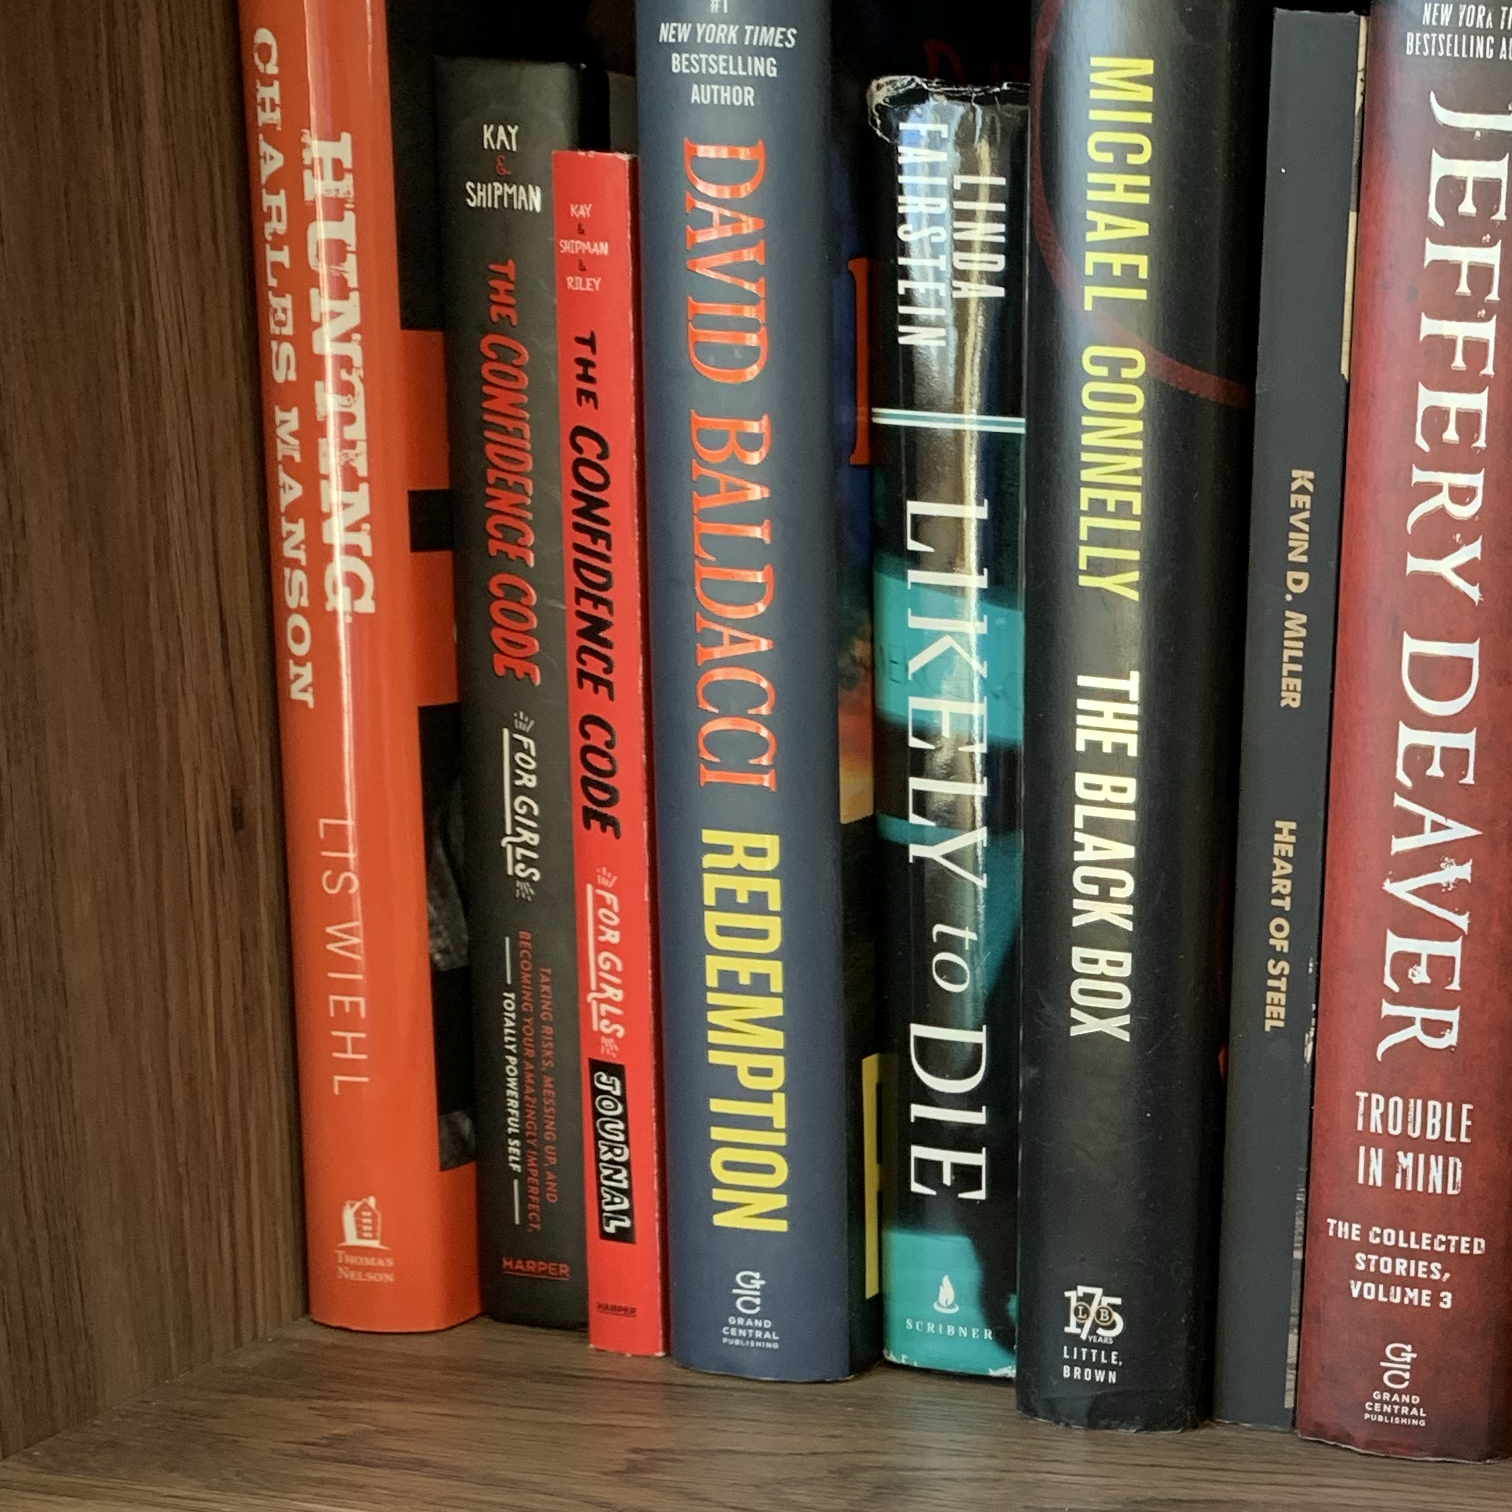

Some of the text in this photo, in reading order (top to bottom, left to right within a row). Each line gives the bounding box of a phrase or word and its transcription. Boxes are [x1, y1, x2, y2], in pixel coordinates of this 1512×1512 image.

[659, 22, 797, 49] NEW YORK TIMES
[1405, 31, 1495, 60] BESTSELLING
[671, 54, 778, 78] BESTSELLING
[690, 84, 755, 107] AUTHOR
[482, 124, 519, 151] KAY
[465, 182, 542, 213] SHIPMAN
[569, 204, 592, 218] KAY
[559, 240, 608, 256] SHIPMAN
[897, 122, 949, 348] FAIRSTEIN
[952, 175, 1006, 299] LINDA
[566, 276, 601, 292] RILEY
[1077, 57, 1155, 602] MICHAEL CONNELLY
[253, 27, 314, 709] CHARLES MANSON
[302, 128, 376, 624] HUNTING
[684, 137, 779, 793] DAVID BALDACCI
[569, 330, 621, 840] THE CONFIDENCE CODE
[1280, 469, 1314, 708] KEVIN D. MILLER
[907, 499, 989, 1201] LIKELY to DIE
[1068, 670, 1140, 1042] THE BLACK BOX
[1375, 629, 1482, 1064] DEAVER
[1264, 819, 1297, 1032] HEART OF STEEL
[517, 930, 532, 1012] BECOMING
[539, 966, 554, 1021] TAKING
[522, 1014, 536, 1060] YOUR
[540, 1022, 555, 1073] RISKS,
[701, 829, 788, 1233] REDEMPTION
[502, 991, 521, 1174] TOTALLY POWERFUL SELF
[524, 1060, 539, 1148] AMAZINGLY
[542, 1074, 557, 1142] MESSING
[1355, 1090, 1474, 1144] TROUBLE
[594, 1070, 632, 1234] JOURNAL
[1358, 1145, 1463, 1195] IN MIND
[545, 1168, 559, 1204] AND
[1326, 1217, 1487, 1256] THE COLLECTED
[502, 1257, 571, 1276] HARPER
[1354, 1251, 1452, 1281] STORIES,
[1350, 1278, 1454, 1310] VOLUME 3
[722, 1326, 779, 1341] CENTRAL
[722, 1337, 779, 1350] PUBLISHING
[727, 1314, 773, 1328] GRAND
[905, 1317, 994, 1341] SCRIBNER
[1062, 1345, 1123, 1367] LITTLE,
[1062, 1365, 1117, 1384] BROWN
